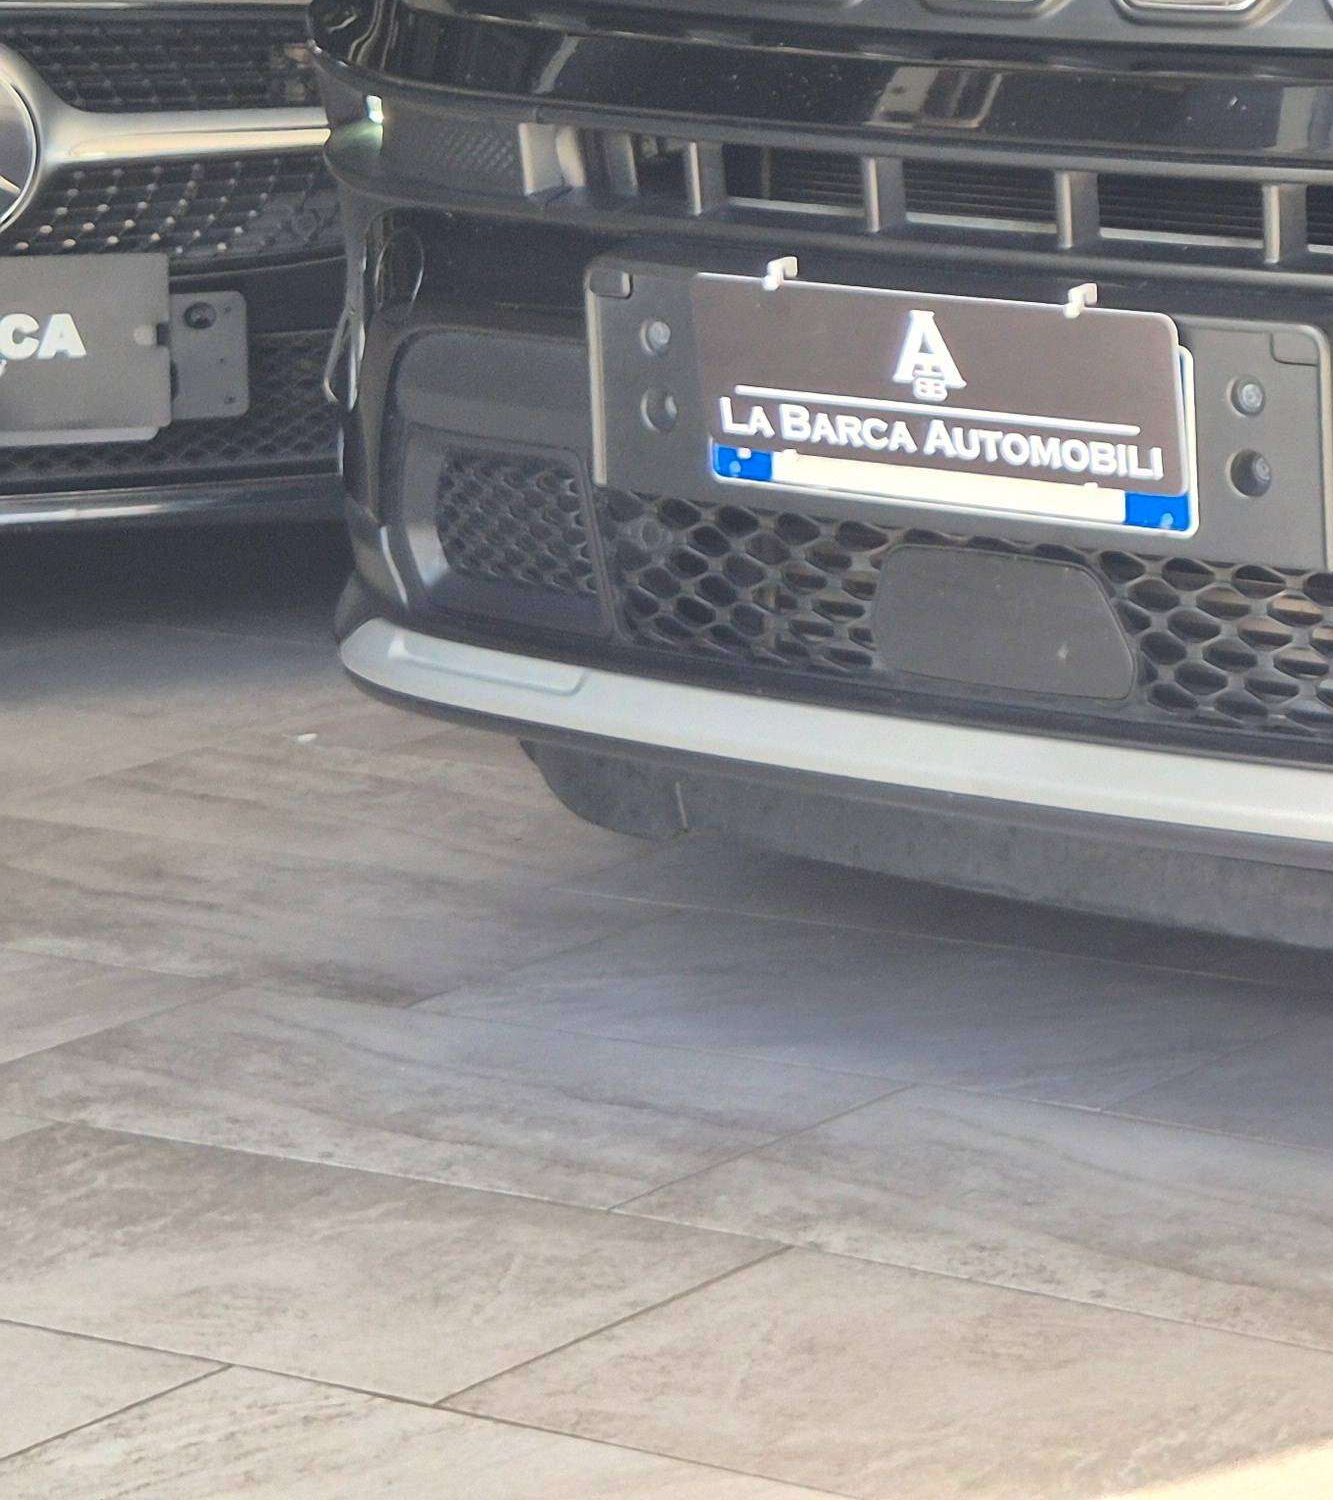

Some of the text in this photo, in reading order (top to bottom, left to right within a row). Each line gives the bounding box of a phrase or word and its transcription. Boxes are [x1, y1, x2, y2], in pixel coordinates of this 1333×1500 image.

[0, 313, 87, 360] CA
[719, 396, 1165, 481] LA BARCA AUTOMOBILI
